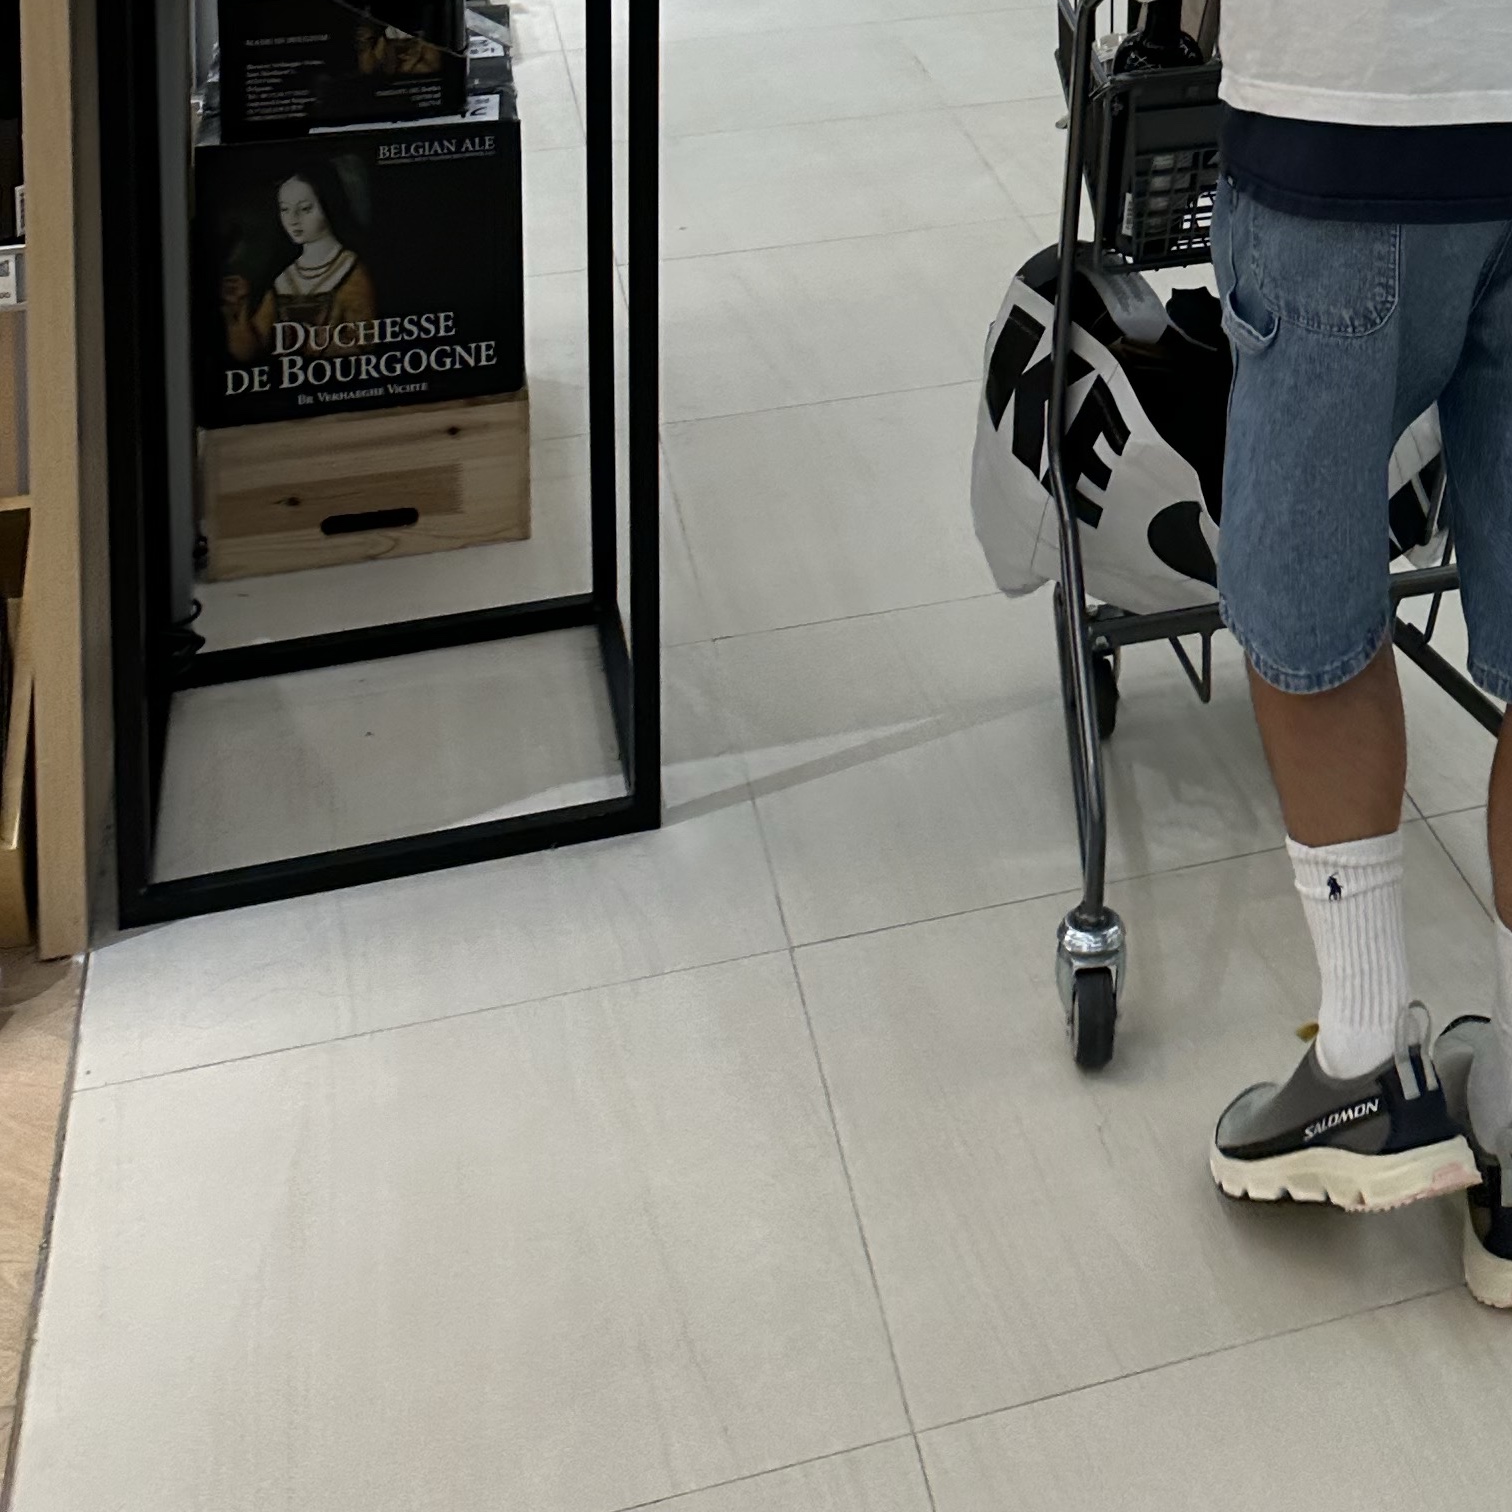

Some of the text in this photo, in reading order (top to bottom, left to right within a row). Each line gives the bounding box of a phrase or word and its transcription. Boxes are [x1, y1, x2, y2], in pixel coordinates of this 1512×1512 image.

[378, 139, 458, 159] BELGIAN
[461, 135, 495, 152] ALE
[1303, 1099, 1379, 1142] SALOMON
